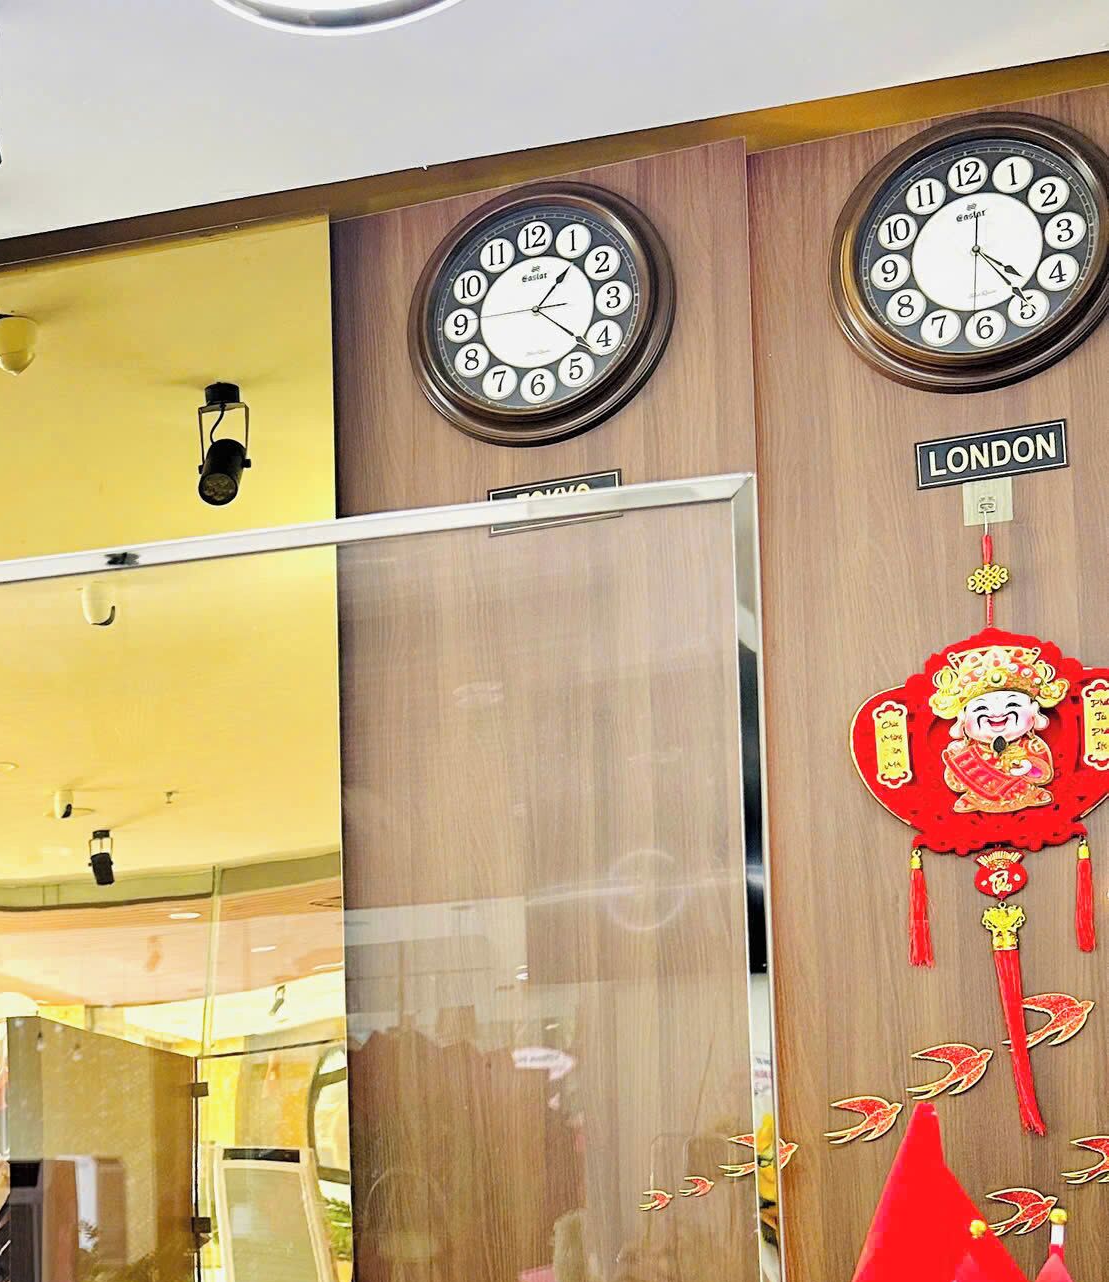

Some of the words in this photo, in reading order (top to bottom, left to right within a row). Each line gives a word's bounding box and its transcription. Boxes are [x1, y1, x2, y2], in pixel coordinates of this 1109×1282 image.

[955, 161, 982, 188] 12
[1009, 162, 1017, 186] 1
[916, 182, 935, 208] 11
[1039, 182, 1058, 207] 2
[523, 225, 547, 250] 12
[570, 229, 576, 252] 1
[885, 218, 911, 244] 10
[1056, 218, 1074, 242] 3
[488, 242, 505, 266] 11
[594, 251, 610, 274] 2
[881, 259, 899, 283] 9
[1048, 260, 1067, 283] 4
[460, 275, 481, 300] 10
[606, 286, 621, 309] 3
[897, 294, 915, 318] 8
[453, 314, 469, 336] 9
[596, 325, 612, 348] 4
[931, 315, 947, 338] 7
[975, 315, 994, 339] 6
[464, 349, 479, 371] 8
[569, 356, 584, 380] 5
[492, 370, 507, 393] 7
[530, 373, 546, 396] 6
[928, 431, 1057, 477] LONDON
